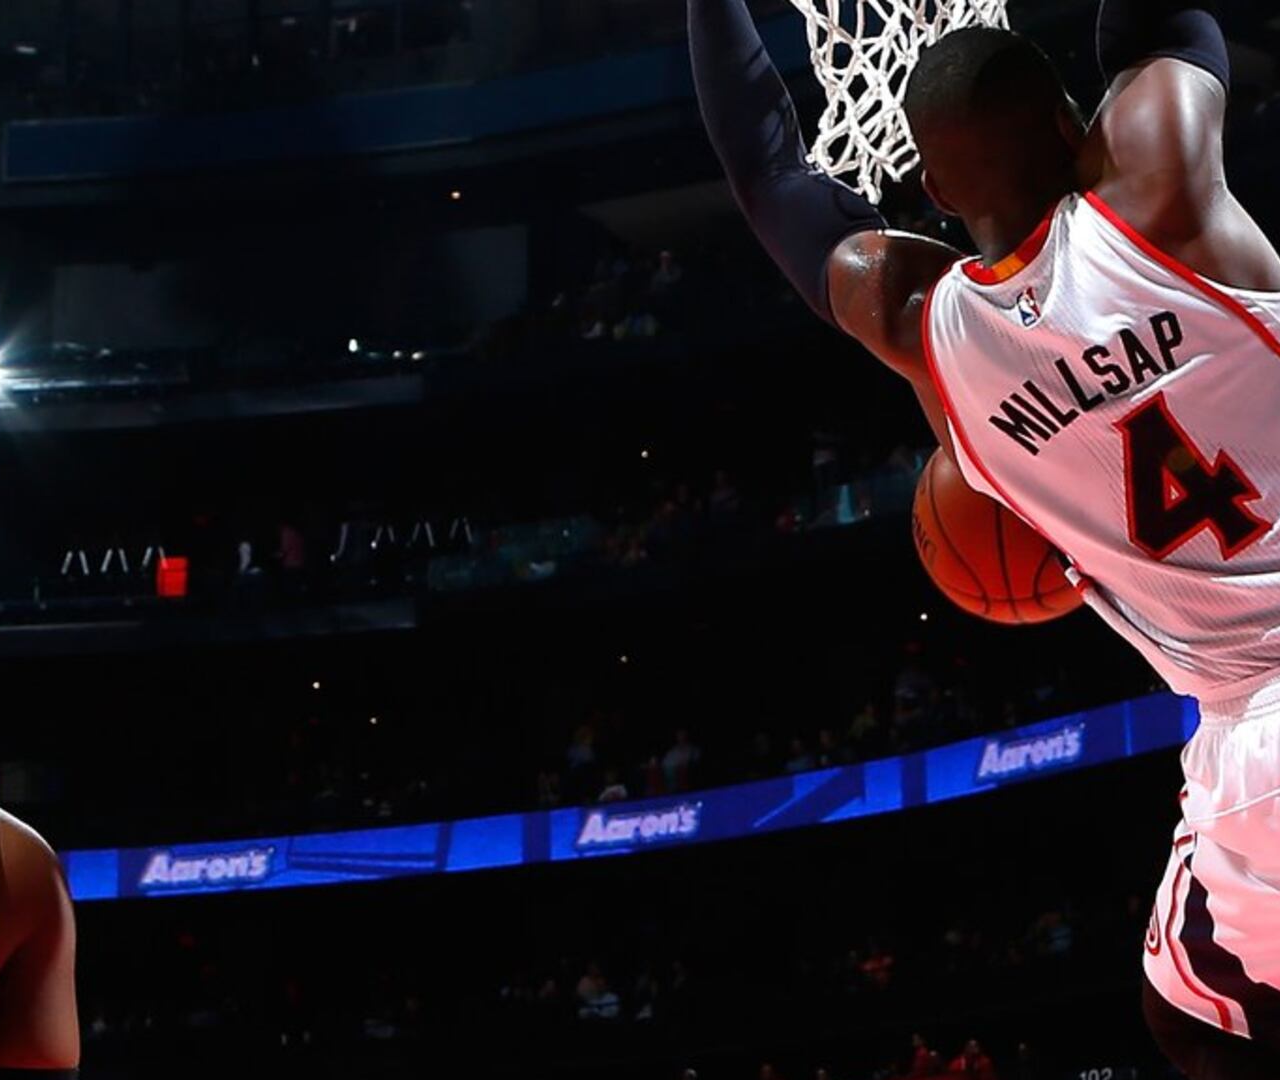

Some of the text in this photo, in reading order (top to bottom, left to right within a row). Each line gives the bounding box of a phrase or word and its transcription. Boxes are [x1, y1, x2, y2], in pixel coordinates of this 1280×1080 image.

[989, 310, 1185, 455] MILLSAP
[1113, 391, 1274, 561] 4
[978, 728, 1084, 776] Aaron's
[578, 805, 701, 845] Aaron's
[140, 851, 273, 883] Aaron's
